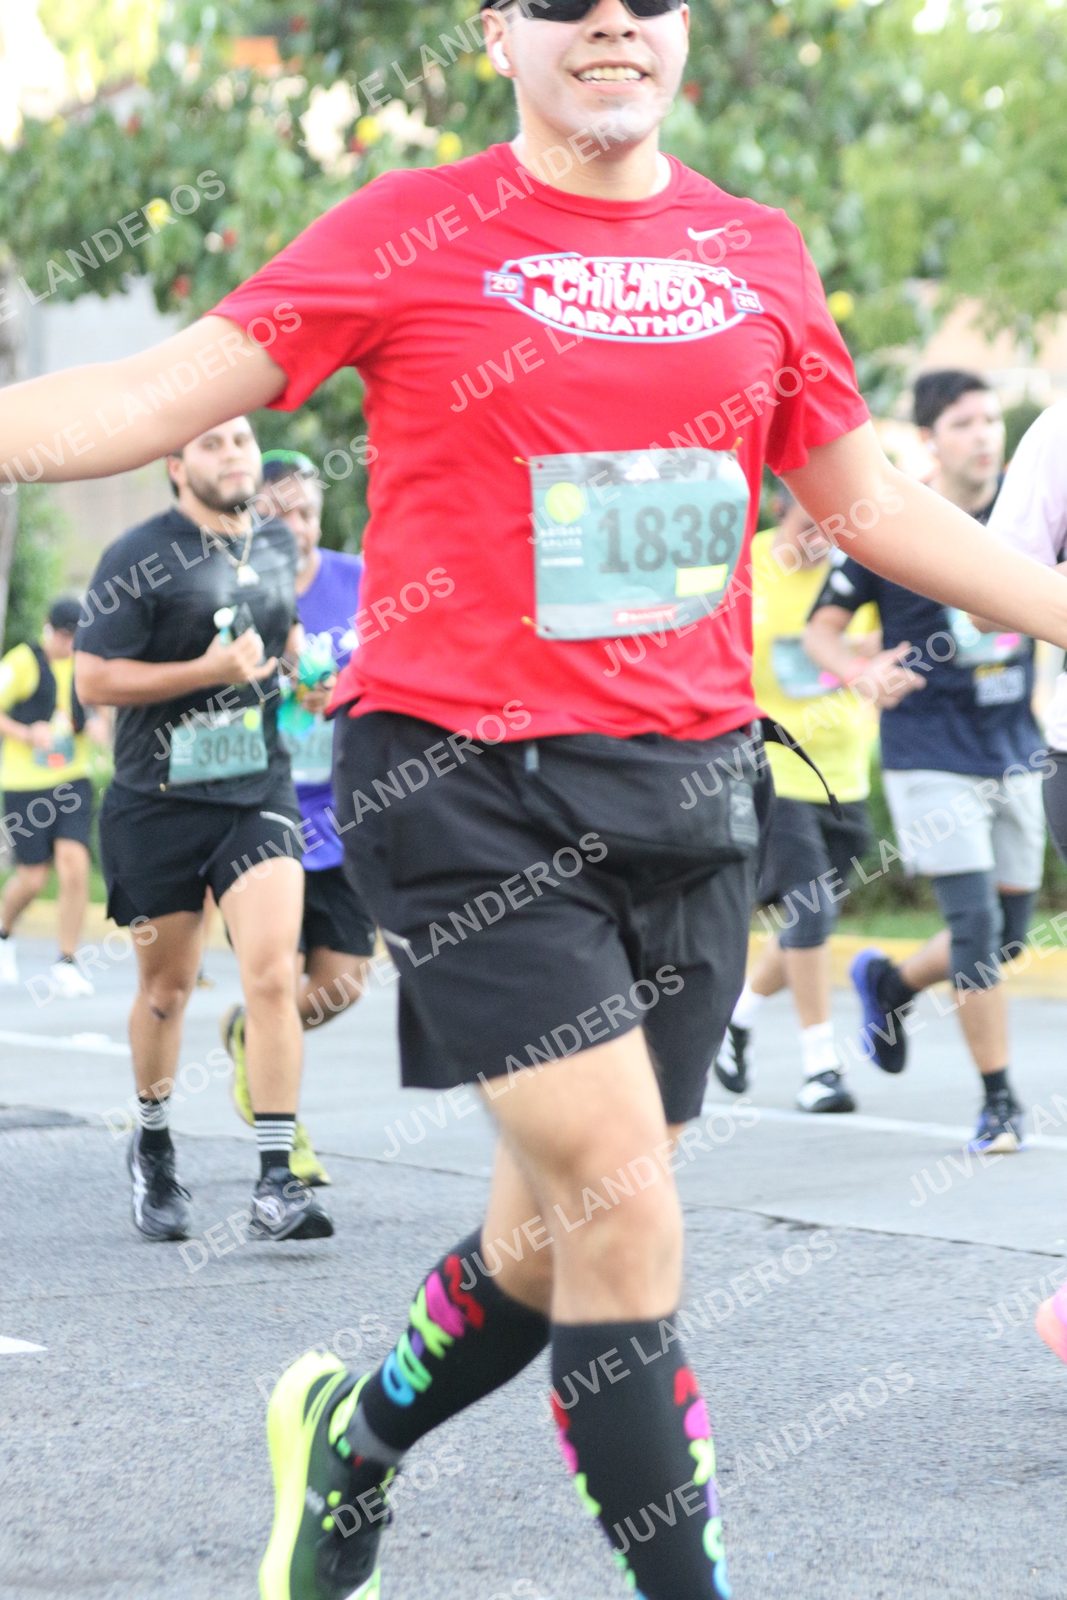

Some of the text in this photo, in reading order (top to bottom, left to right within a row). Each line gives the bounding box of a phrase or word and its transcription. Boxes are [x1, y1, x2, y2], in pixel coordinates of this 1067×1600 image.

[490, 275, 519, 292] 20
[554, 271, 705, 311] CHICAGO
[533, 287, 725, 335] MARATHON
[597, 502, 738, 573] 1838
[198, 734, 262, 765] 3046
